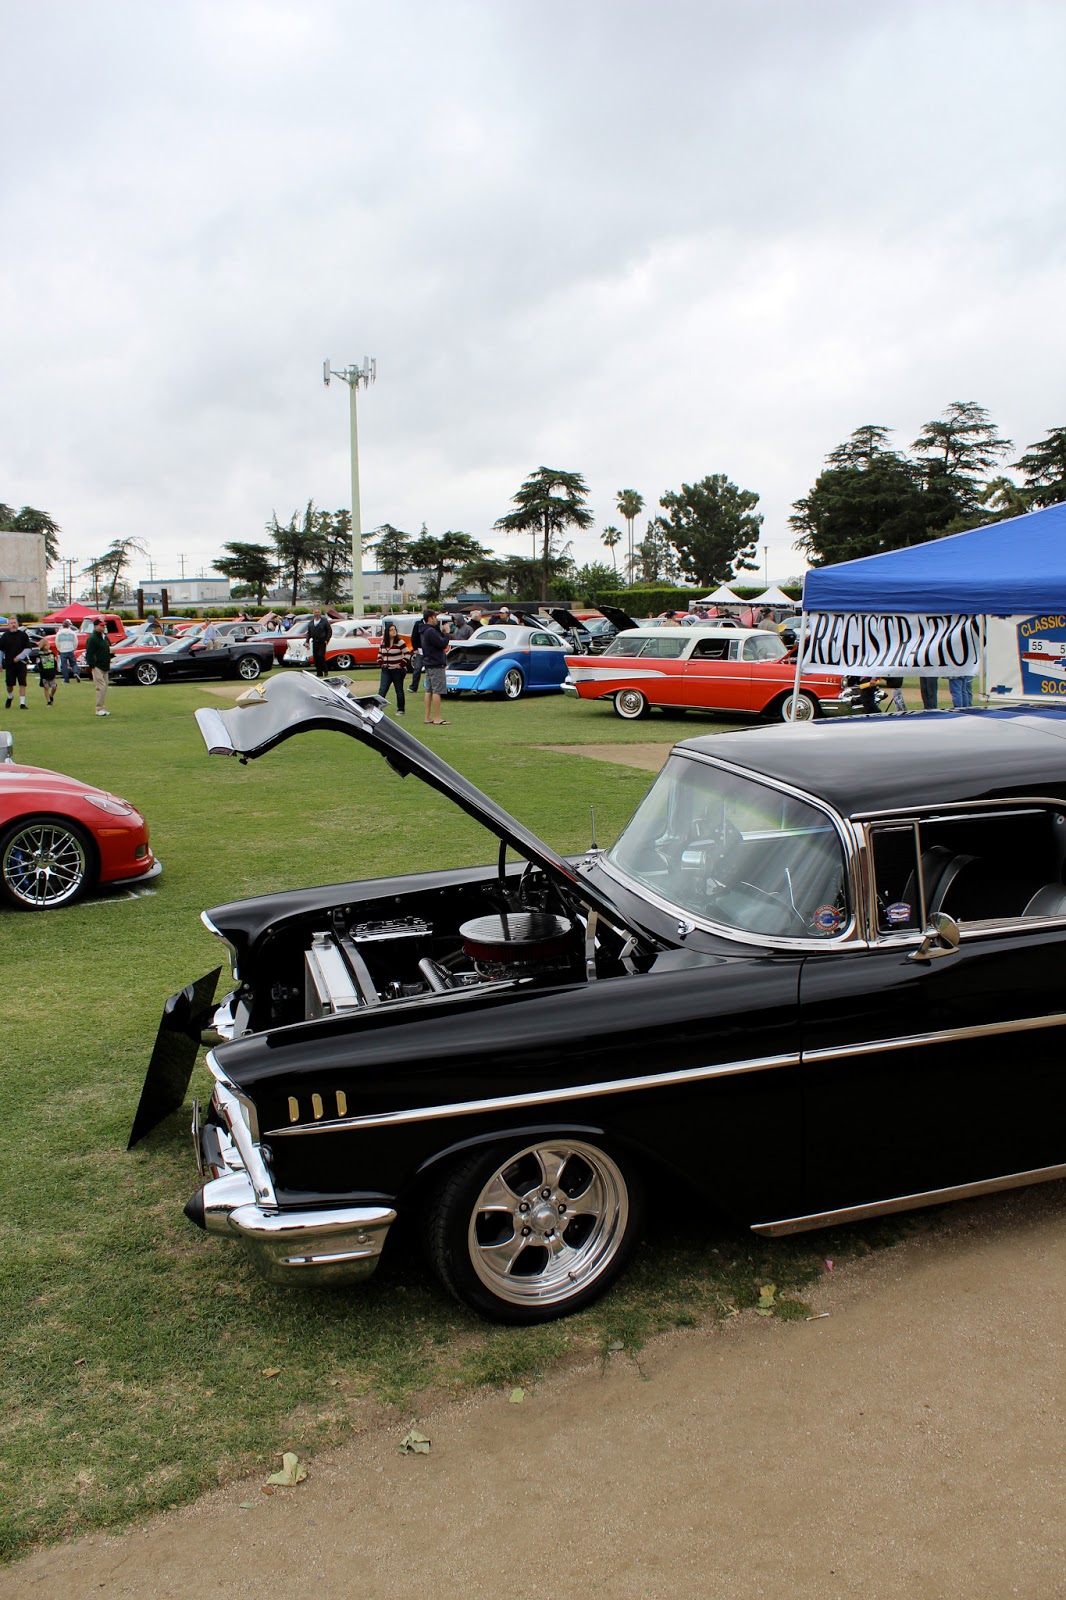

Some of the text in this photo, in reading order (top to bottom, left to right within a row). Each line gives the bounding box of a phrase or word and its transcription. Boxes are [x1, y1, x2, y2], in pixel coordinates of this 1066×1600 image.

[1020, 615, 1066, 637] CLASSIC
[810, 613, 987, 667] REGISTRATION
[1031, 641, 1043, 651] 55
